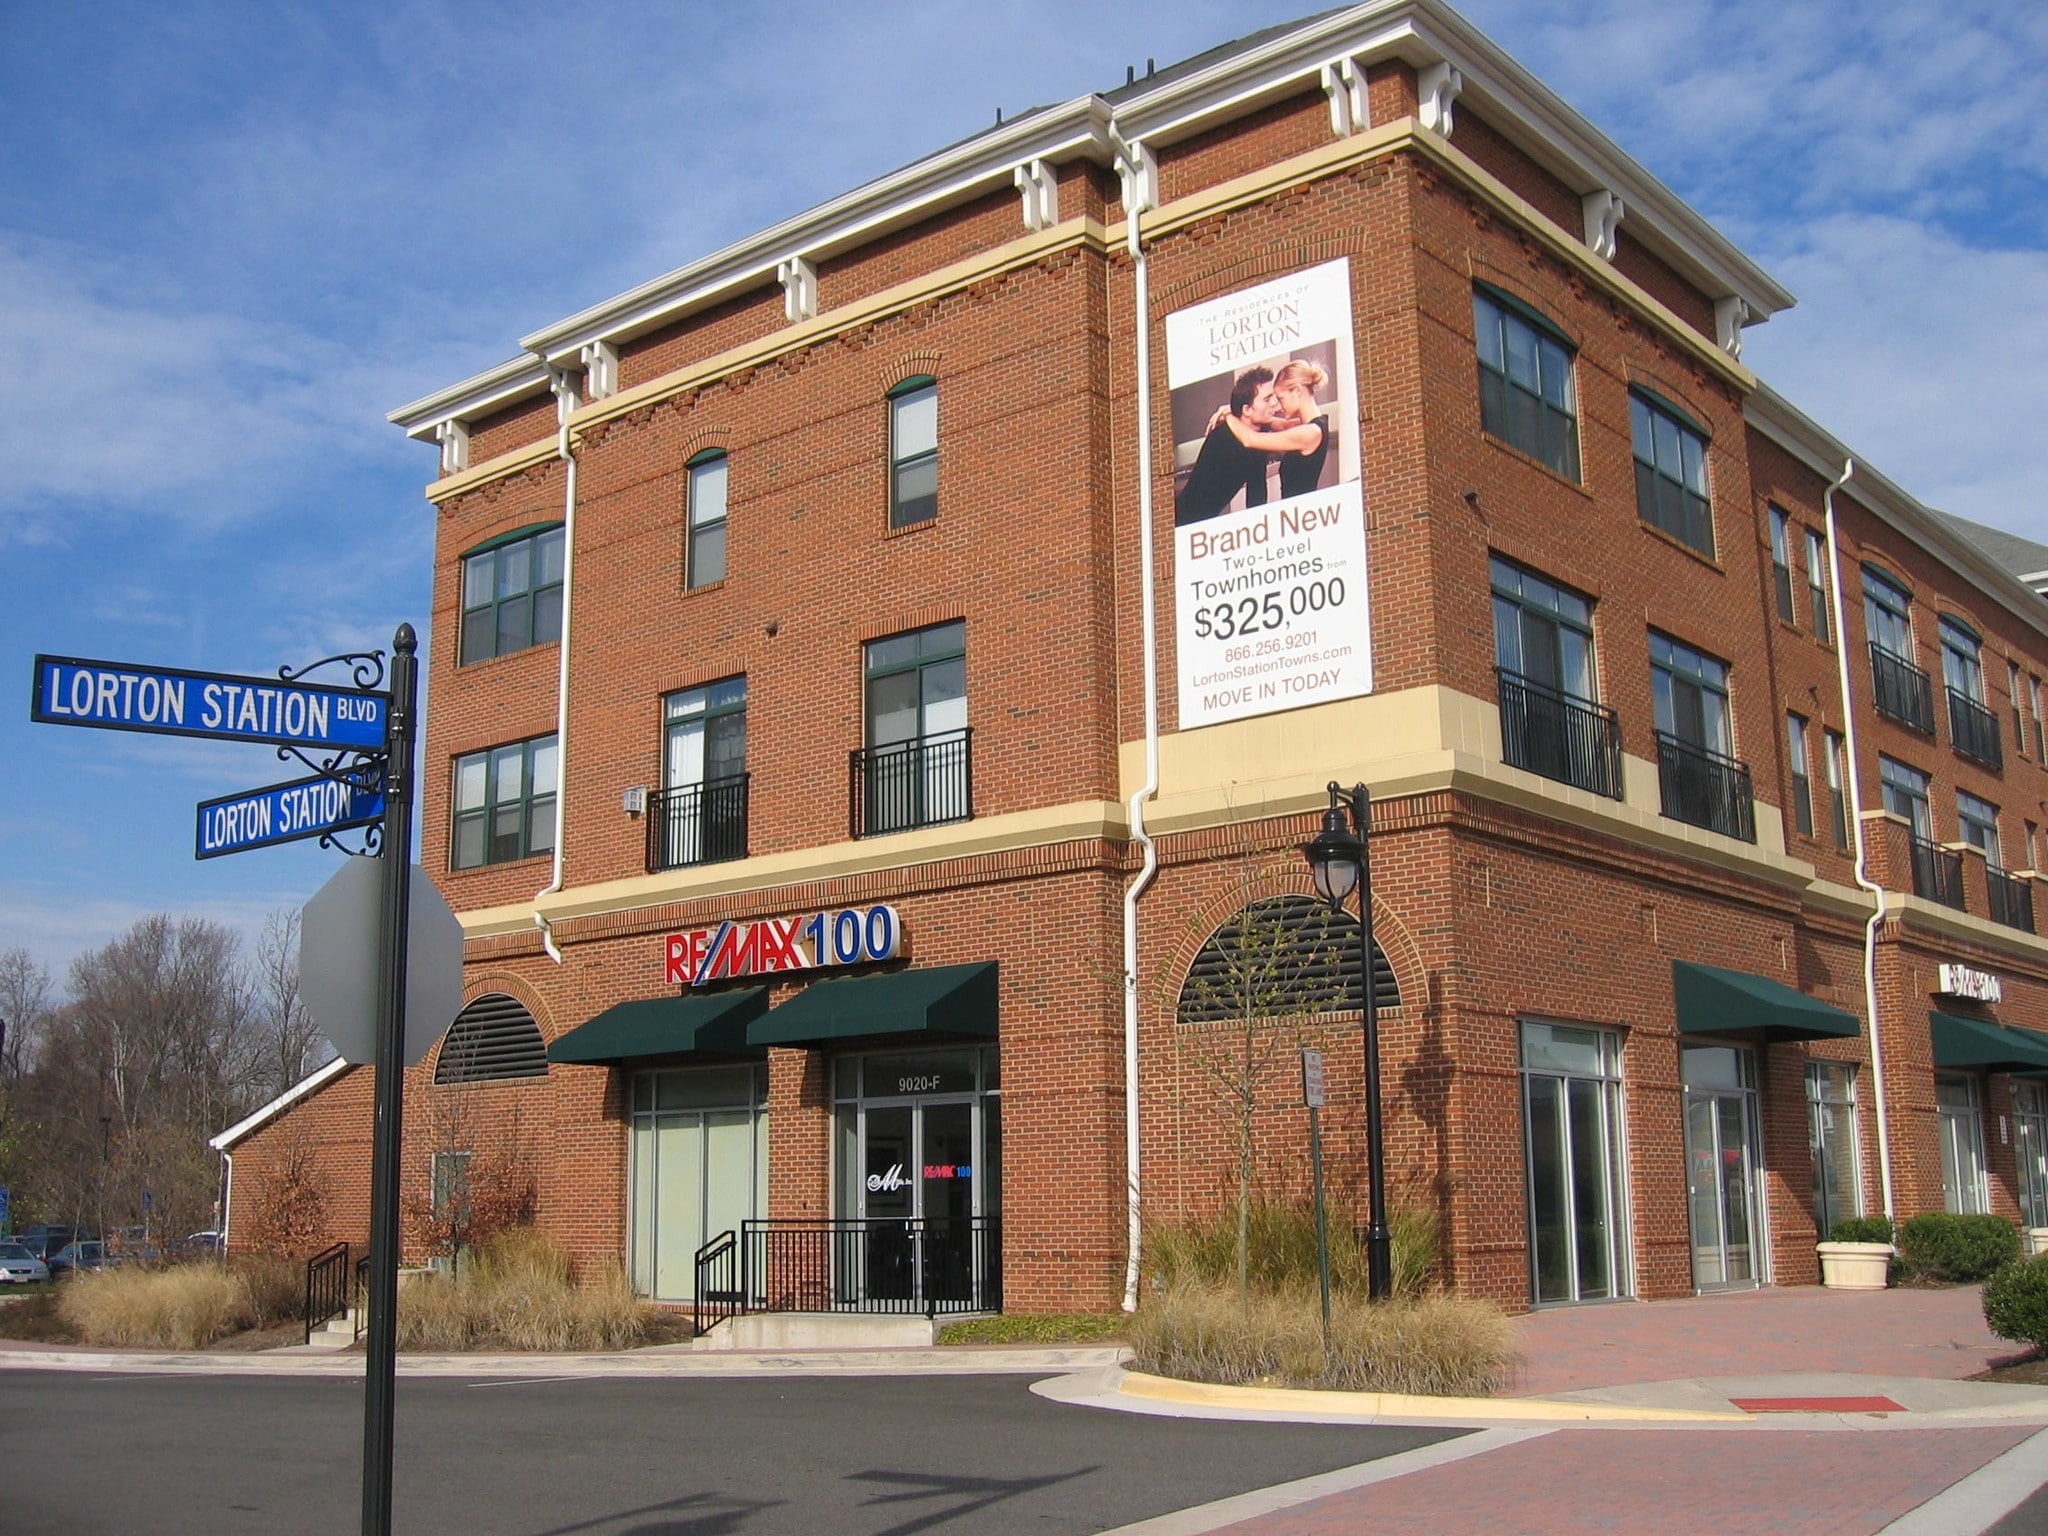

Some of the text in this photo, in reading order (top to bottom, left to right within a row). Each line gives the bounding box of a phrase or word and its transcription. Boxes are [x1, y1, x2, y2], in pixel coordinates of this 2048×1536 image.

[1210, 300, 1300, 344] LORTON
[1210, 321, 1301, 366] STATION
[1190, 503, 1341, 560] Brand New
[1223, 538, 1311, 571] Two-Level
[1190, 557, 1324, 600] Townhomes
[1195, 577, 1345, 640] $325,000
[1193, 645, 1353, 687] LortonStationTowns.com
[1225, 630, 1317, 662] 866.256.9201
[50, 667, 377, 738] LORTON STATION BLVD
[1204, 668, 1341, 711] MOVE IN TODAY
[204, 799, 271, 850] LORTON
[279, 775, 352, 833] STATION
[665, 905, 899, 986] RE/MAX 100
[899, 1075, 941, 1092] 9020-F
[957, 1166, 972, 1177] 100
